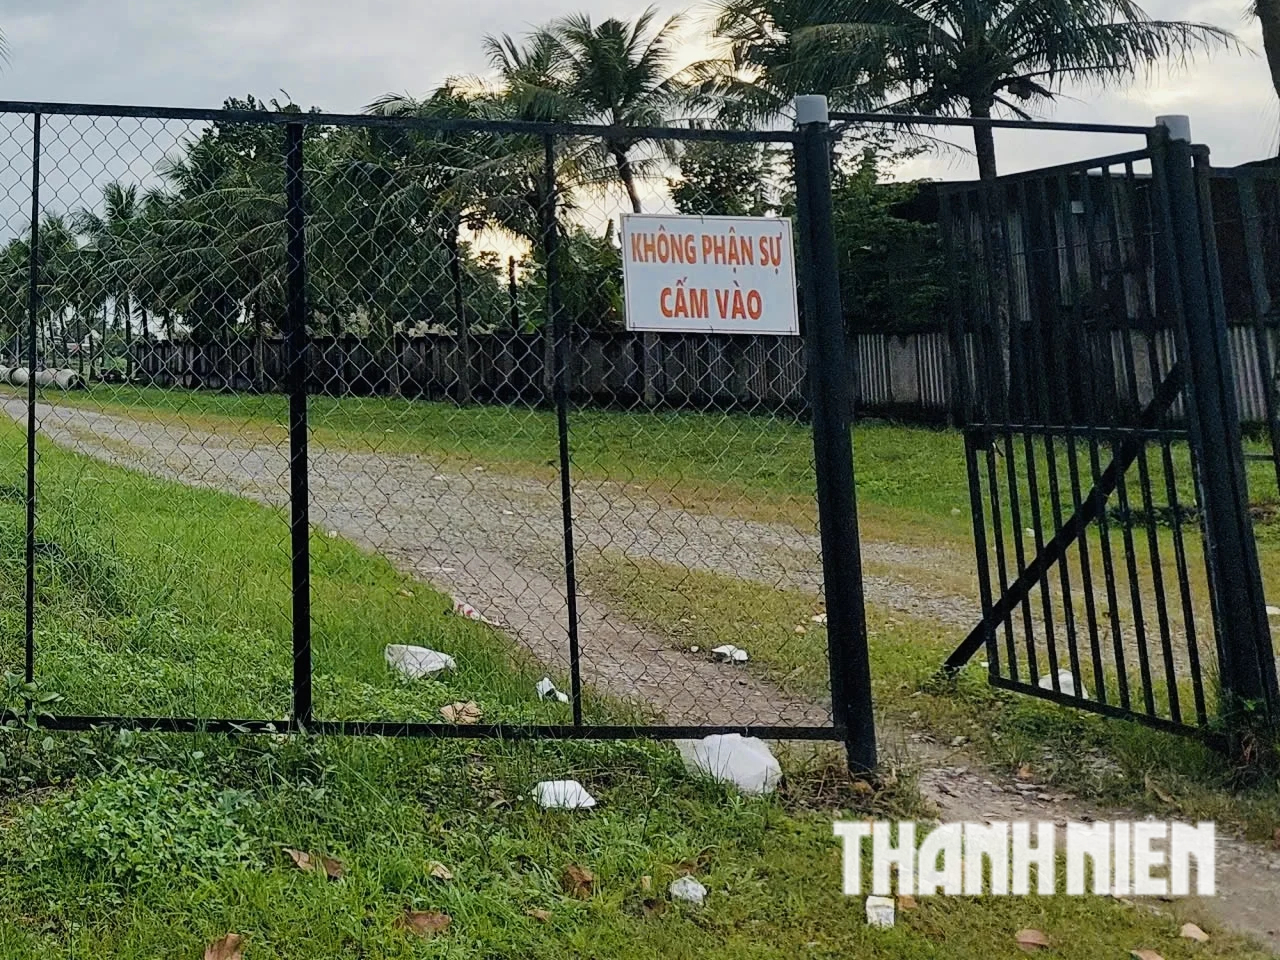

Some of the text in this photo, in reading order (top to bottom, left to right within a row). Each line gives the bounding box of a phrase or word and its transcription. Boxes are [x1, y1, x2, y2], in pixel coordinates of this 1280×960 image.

[631, 224, 783, 275] KHÔNG PHẬN SỰ
[660, 276, 763, 320] CẤM VÀO
